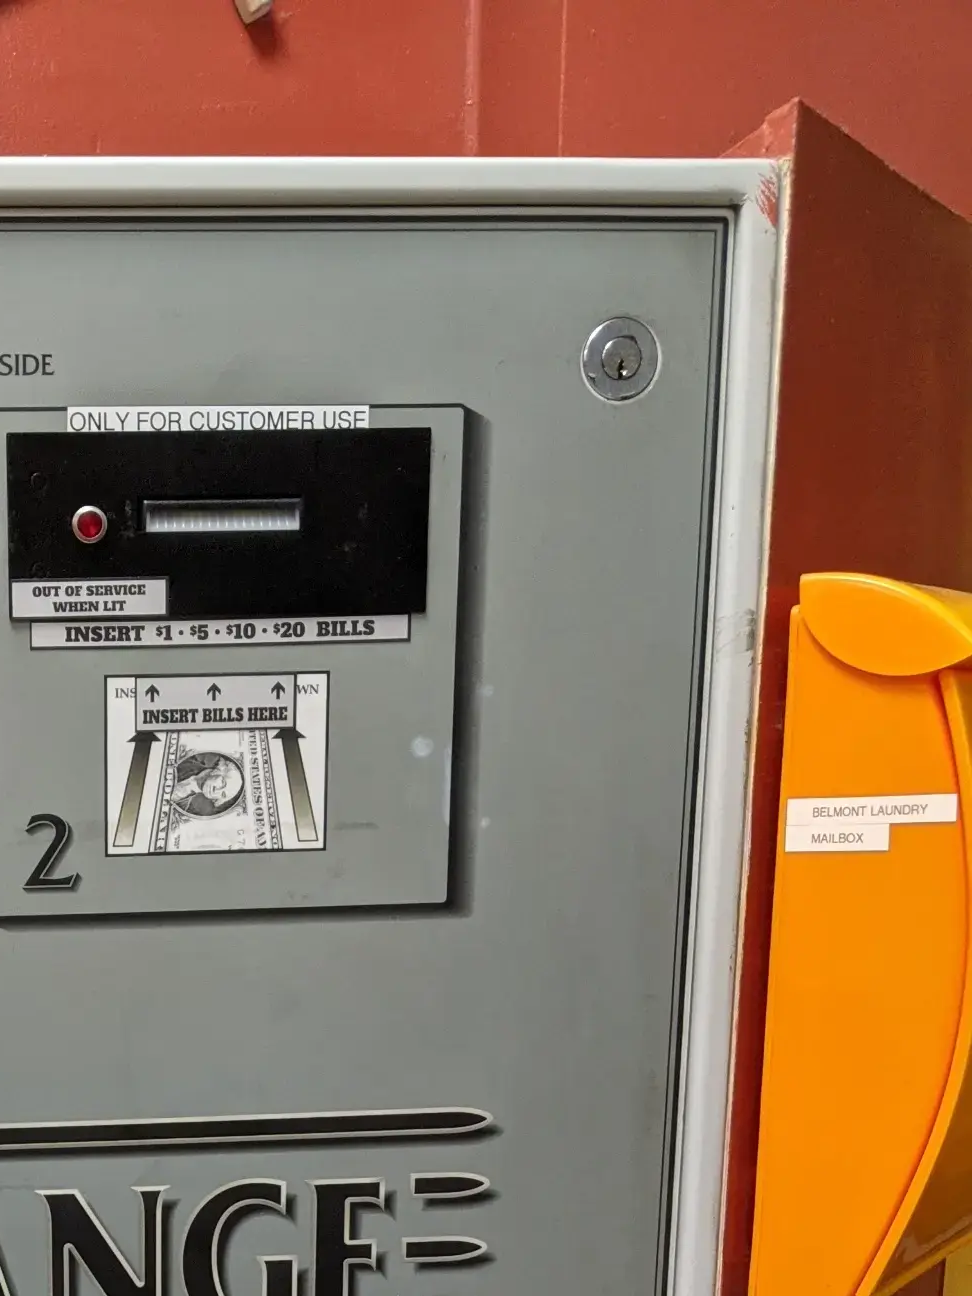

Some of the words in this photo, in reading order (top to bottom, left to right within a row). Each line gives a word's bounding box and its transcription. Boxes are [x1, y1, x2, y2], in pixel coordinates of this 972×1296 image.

[69, 412, 130, 432] ONLY
[137, 411, 182, 431] FOR
[189, 411, 315, 431] CUSTOMER
[323, 410, 367, 429] USE
[31, 585, 60, 598] OUT
[64, 585, 83, 597] OF
[86, 584, 146, 597] SERVICE
[53, 600, 99, 613] WHEN
[102, 600, 127, 612] LIT
[65, 625, 146, 643] INSERT
[155, 623, 173, 641] $1
[189, 623, 209, 641] $5
[225, 622, 256, 640] $10
[273, 621, 305, 638] $20
[316, 619, 376, 637] BILLS
[142, 708, 199, 724] INSERT
[202, 707, 244, 723] BILLS
[248, 706, 288, 721] HERE
[812, 805, 867, 818] BELMONT
[870, 804, 928, 816] LAUNDRY
[811, 833, 864, 844] MAILBOX
[22, 813, 82, 892] 2
